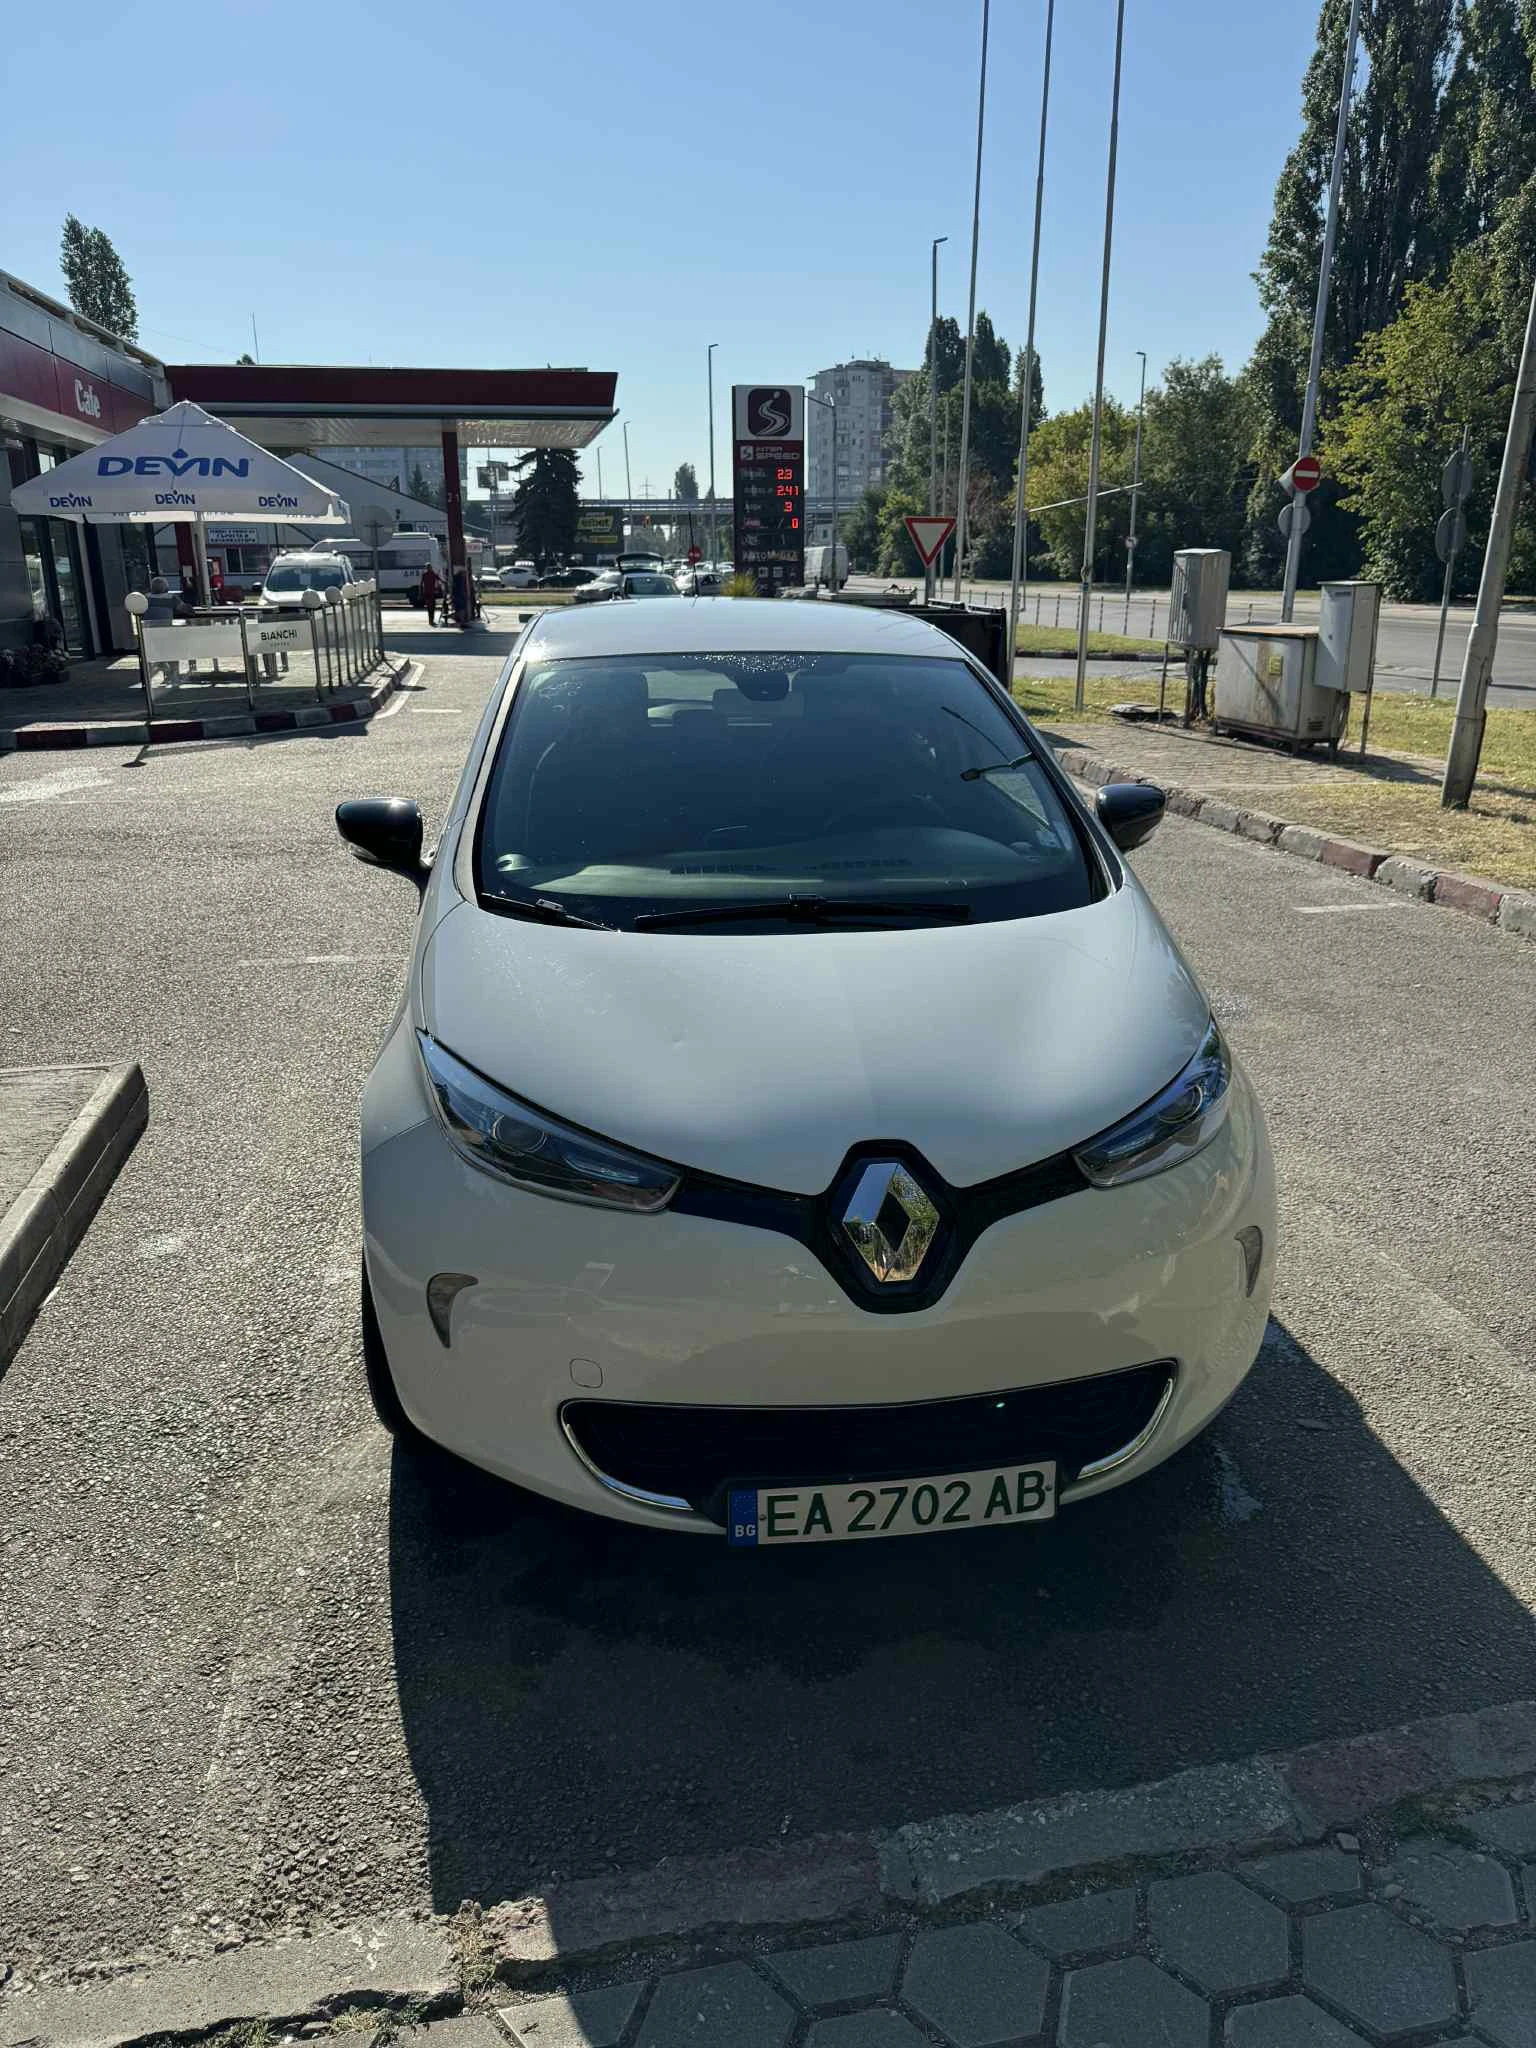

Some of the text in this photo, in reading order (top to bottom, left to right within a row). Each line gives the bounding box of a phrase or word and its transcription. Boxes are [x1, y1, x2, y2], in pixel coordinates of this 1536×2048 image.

[97, 450, 249, 478] DEVIN
[50, 494, 93, 508] DEVIN
[155, 491, 196, 505] DEVIN
[258, 494, 298, 508] DEVIN
[260, 629, 298, 641] BIANCHI
[767, 1470, 1047, 1538] EA 2702 AB
[734, 1525, 757, 1538] BG
